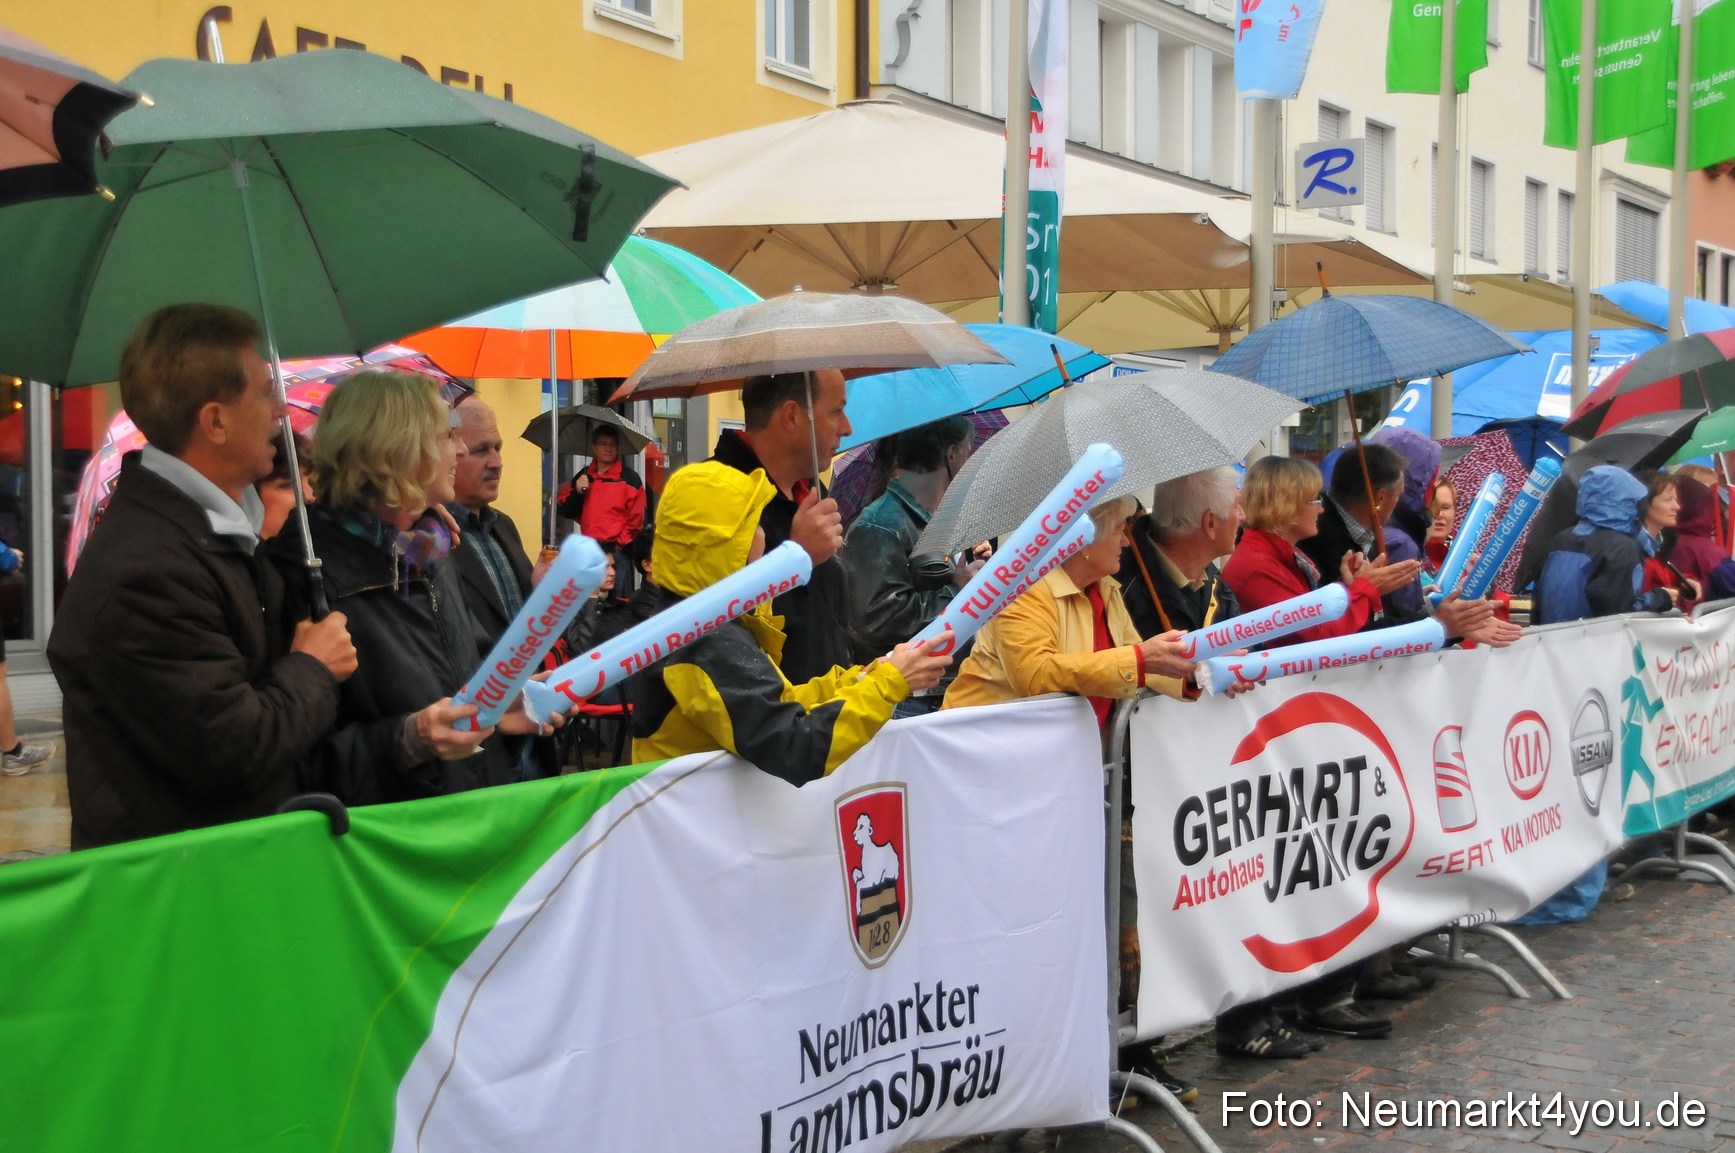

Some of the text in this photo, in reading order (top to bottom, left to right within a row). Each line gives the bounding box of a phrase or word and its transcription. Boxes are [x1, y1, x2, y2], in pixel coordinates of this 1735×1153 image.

[1413, 3, 1441, 18] Gen
[1303, 148, 1357, 199] R.
[960, 469, 1107, 620] TUI ReiseCenter
[1463, 498, 1528, 599] www.maxi-dsl.de
[475, 578, 584, 709] TUI ReiseCenter
[620, 574, 801, 676] TUI ReiseCenter
[1205, 603, 1323, 650] TUI ReiseCenter
[1280, 642, 1433, 677] TUI ReiseCenter
[1173, 755, 1387, 867] GERHART &
[1501, 803, 1561, 855] KIA MOTORS
[1172, 853, 1264, 911] Autohaus
[1416, 839, 1494, 878] SEAT
[798, 979, 979, 1084] Neumarkter
[760, 1034, 1005, 1153] Lammsbräu
